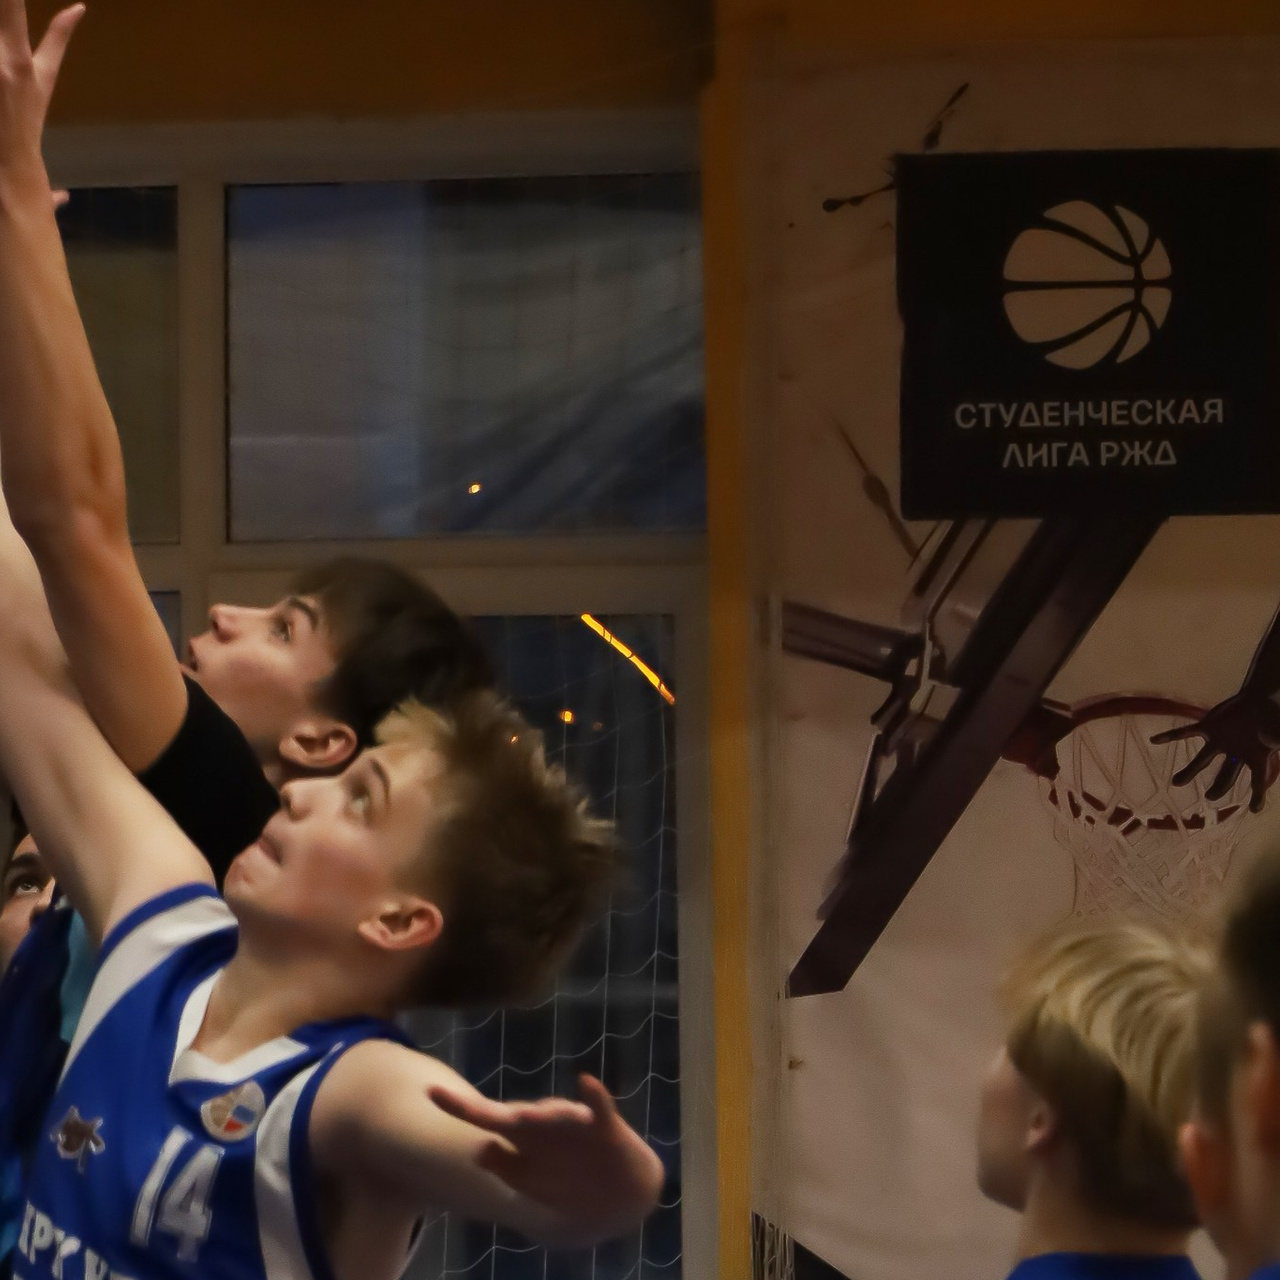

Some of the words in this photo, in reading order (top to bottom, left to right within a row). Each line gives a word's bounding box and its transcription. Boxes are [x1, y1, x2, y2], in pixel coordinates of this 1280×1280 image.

[955, 398, 1224, 429] СТУДЕНЧЕСКАЯ
[1002, 442, 1090, 468] ЛИГА
[1100, 440, 1177, 466] РЖД
[130, 1124, 226, 1263] 14
